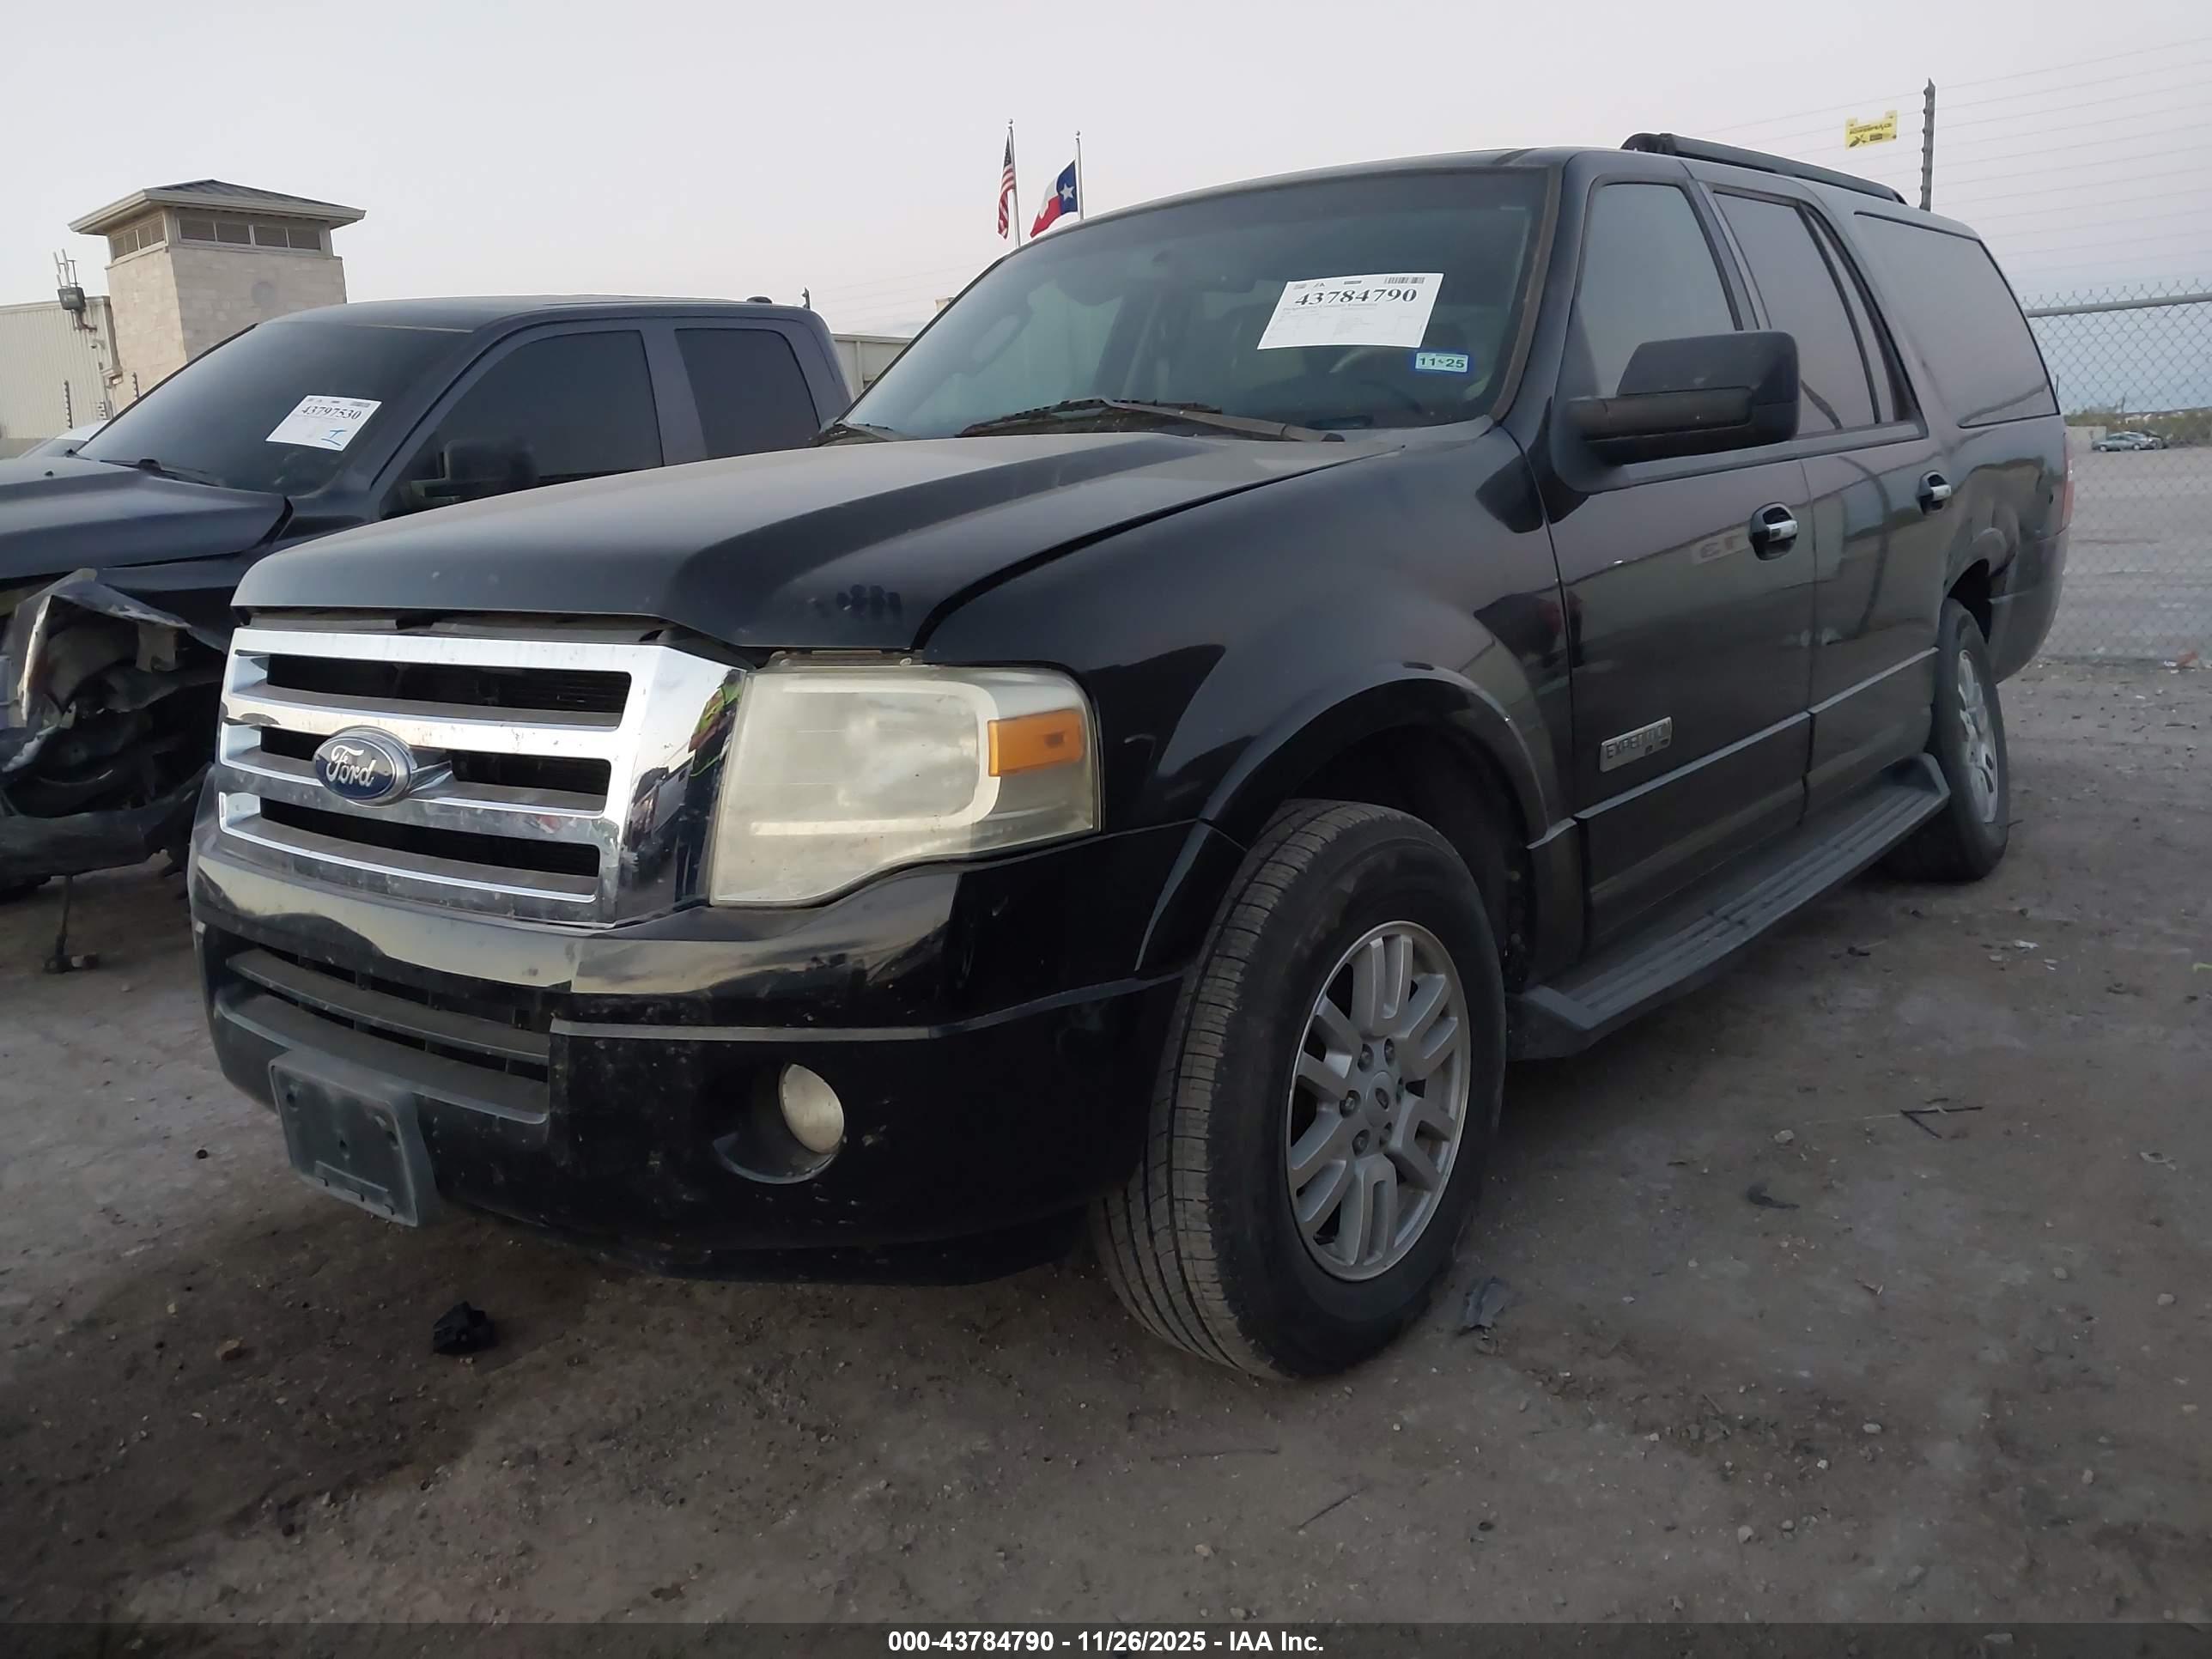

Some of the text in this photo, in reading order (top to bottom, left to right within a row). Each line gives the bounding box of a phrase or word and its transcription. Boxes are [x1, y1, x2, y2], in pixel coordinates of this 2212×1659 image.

[1294, 288, 1419, 306] 43784790
[301, 405, 362, 420] 43797530
[325, 744, 378, 787] Ford
